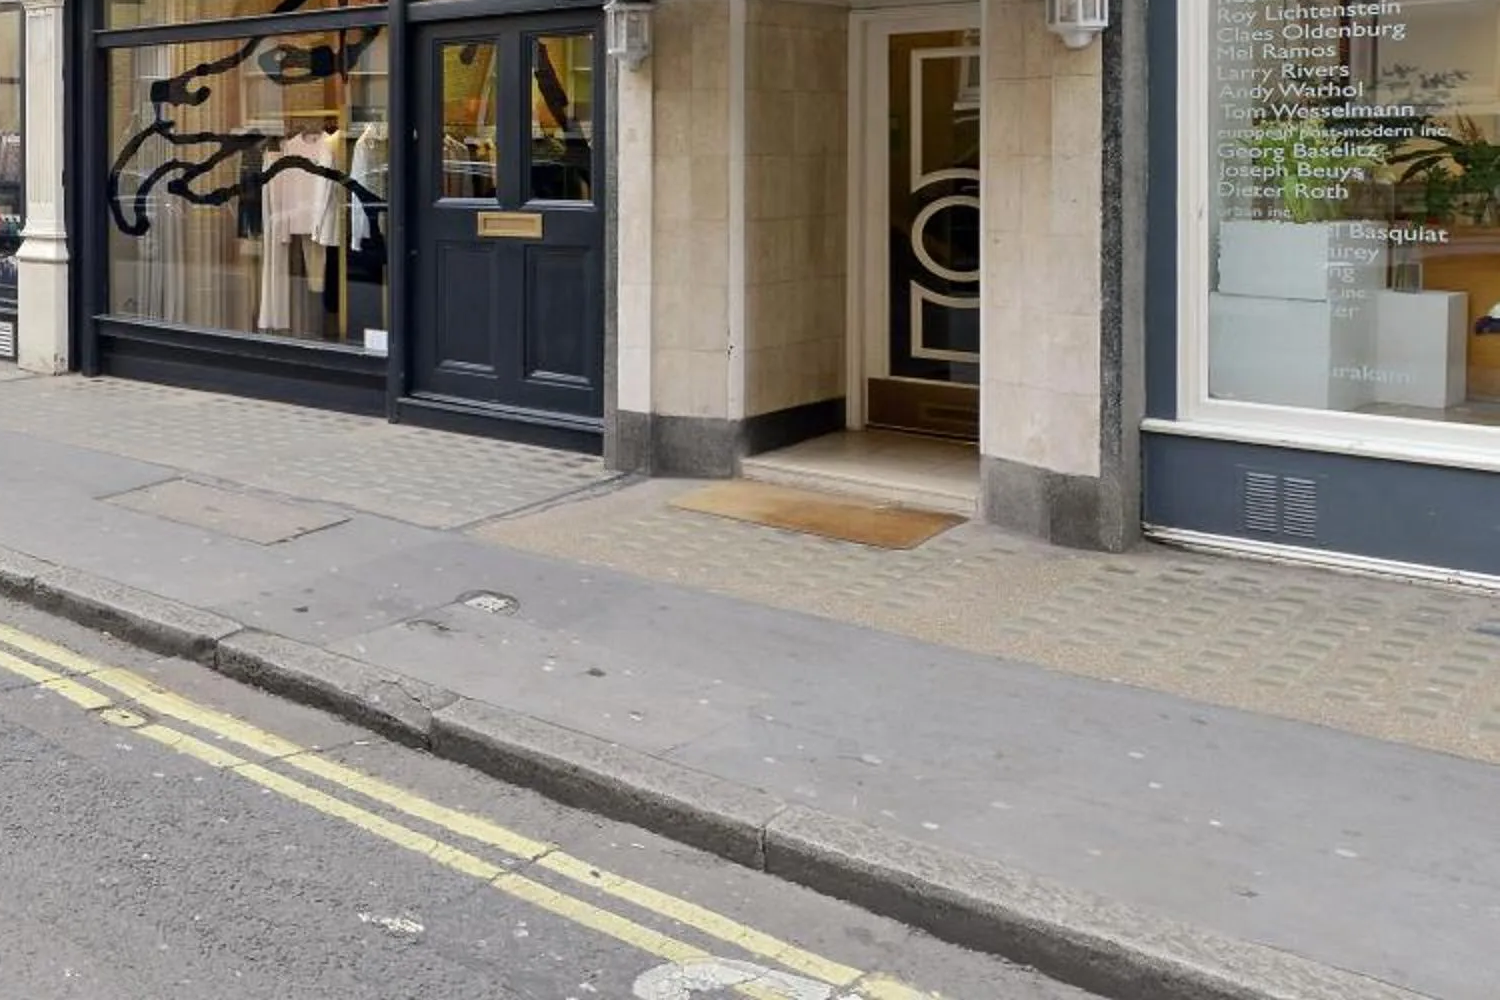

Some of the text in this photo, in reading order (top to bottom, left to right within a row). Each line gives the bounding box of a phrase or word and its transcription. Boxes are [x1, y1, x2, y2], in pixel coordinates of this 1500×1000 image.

[1217, 0, 1402, 26] Roy Lichtenstein
[1216, 22, 1407, 43] Claes Oldenburg
[1217, 43, 1337, 60] Mel Ramos
[1217, 63, 1350, 83] Larry Rivers
[1219, 81, 1364, 102] Andy Warhol
[1220, 101, 1416, 120] Tom Wesselmann
[1218, 142, 1378, 162] Georg Baselitz
[1219, 163, 1364, 182] Joseph Beuys
[1218, 181, 1348, 199] Dieter Roth
[1349, 223, 1449, 245] Basquiat
